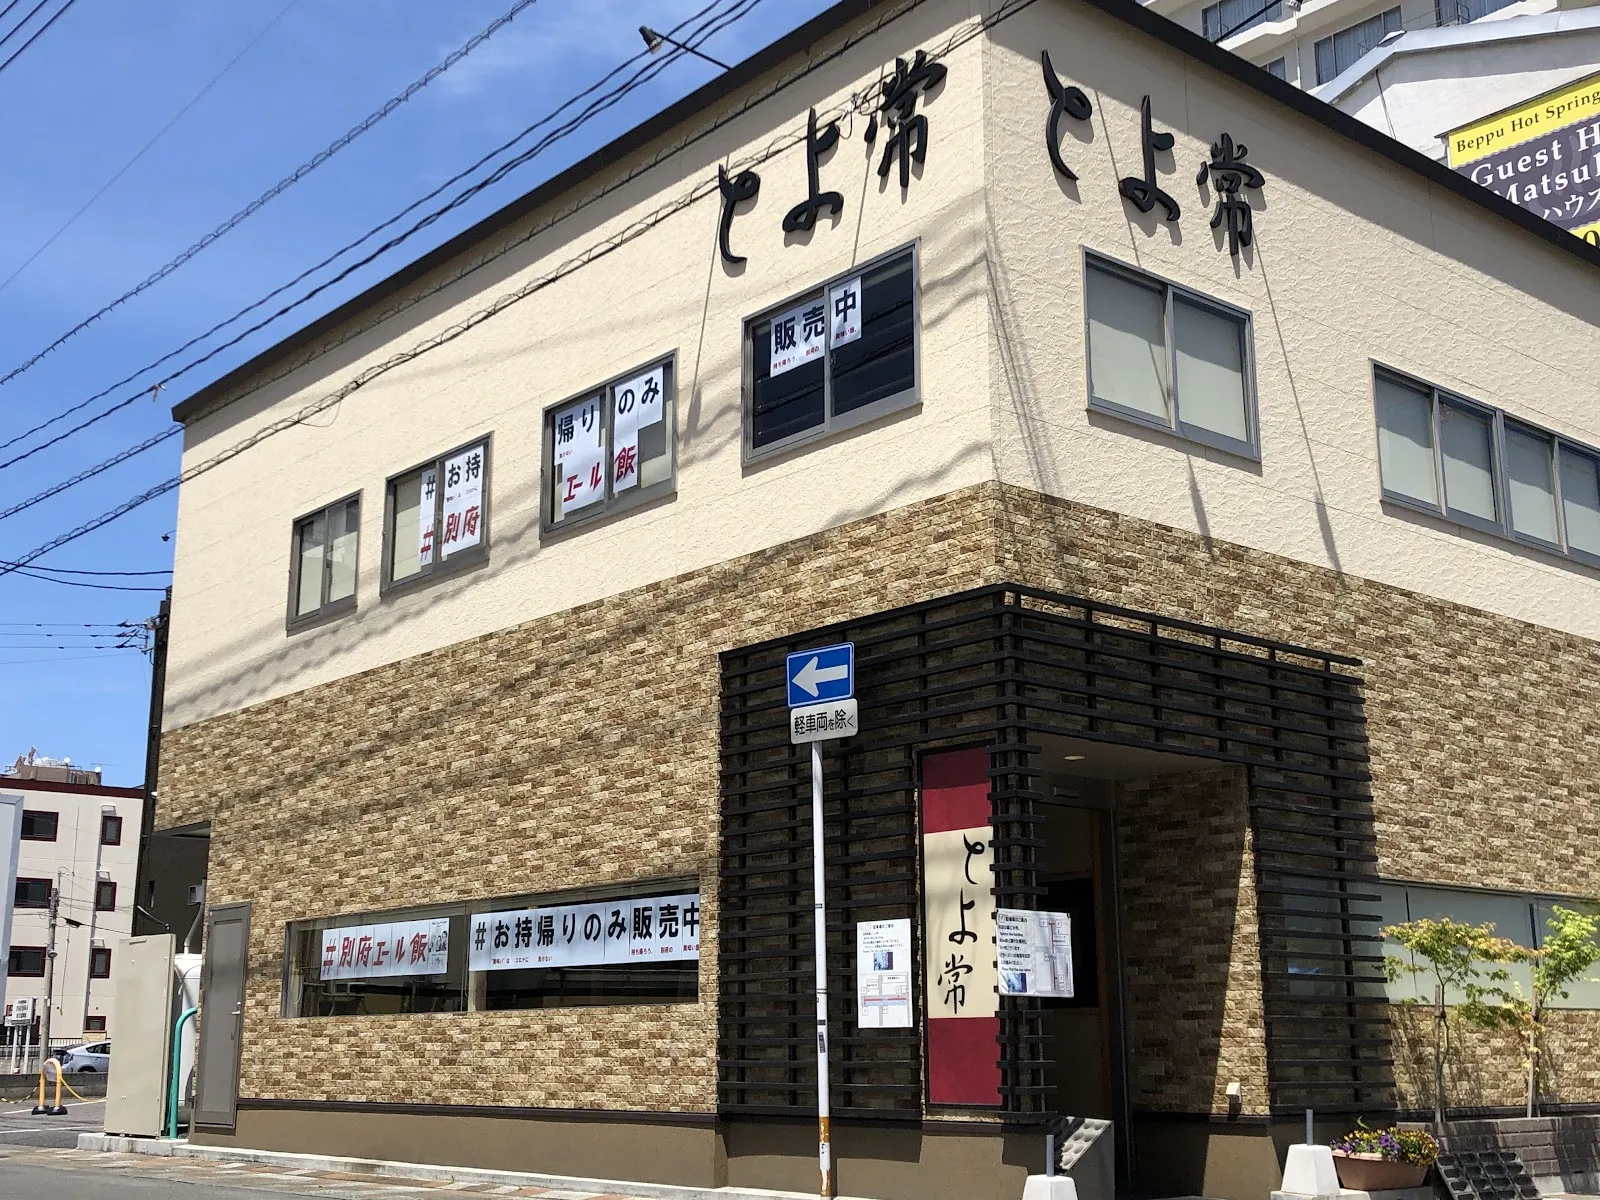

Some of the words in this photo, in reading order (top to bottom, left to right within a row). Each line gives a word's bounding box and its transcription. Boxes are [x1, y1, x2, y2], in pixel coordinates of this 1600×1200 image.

[1041, 49, 1266, 256] とよ常
[1456, 127, 1505, 153] Beppu
[1511, 112, 1540, 132] Hot
[719, 50, 948, 264] とよ常
[1471, 139, 1563, 187] Guest
[794, 708, 854, 736] 軽車両を除く
[937, 833, 986, 1015] とよ常
[323, 931, 429, 976] #別府エール飯
